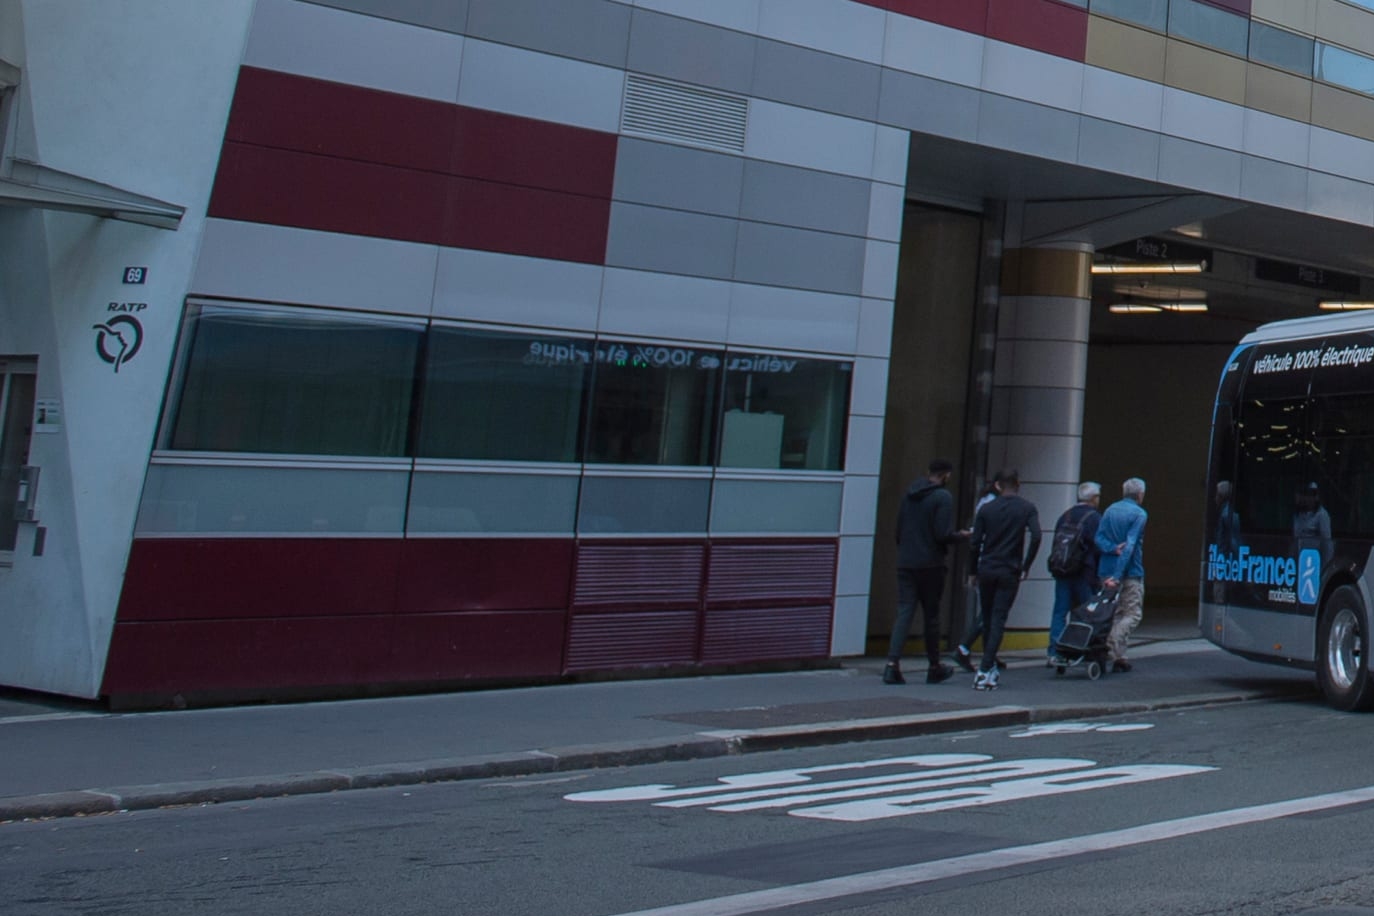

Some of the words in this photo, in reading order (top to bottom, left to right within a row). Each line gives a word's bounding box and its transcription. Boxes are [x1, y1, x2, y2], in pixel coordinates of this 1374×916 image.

[1136, 239, 1159, 256] Piste
[1160, 243, 1168, 258] 2
[127, 268, 142, 282] 69
[107, 302, 148, 312] RATP
[1253, 352, 1293, 375] véhicule
[1292, 349, 1321, 370] 100%
[1320, 344, 1374, 368] électrique
